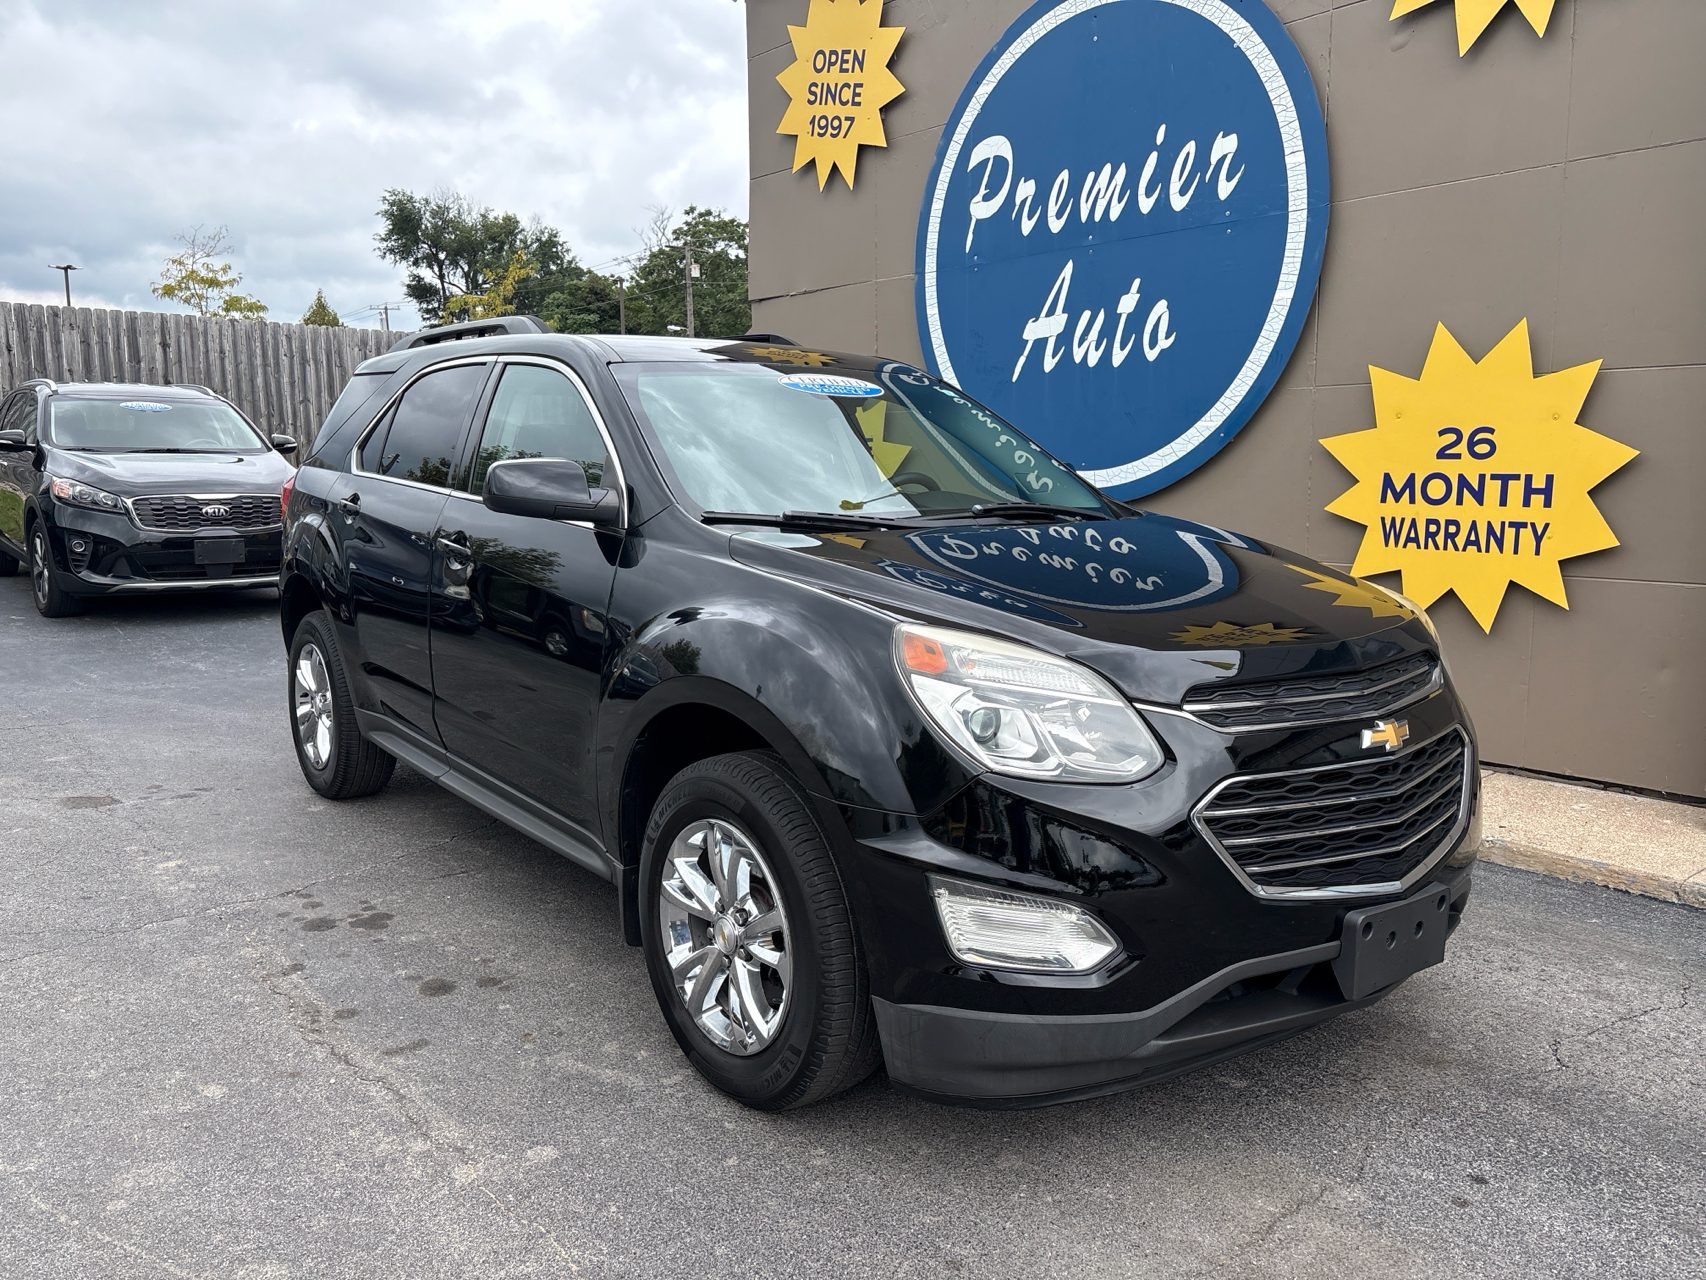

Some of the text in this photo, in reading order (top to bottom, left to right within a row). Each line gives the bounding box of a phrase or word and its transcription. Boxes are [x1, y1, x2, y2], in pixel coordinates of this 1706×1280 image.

[812, 48, 867, 74] OPEN
[806, 81, 864, 107] SINCE
[809, 114, 856, 139] 1997
[965, 123, 1245, 254] Premier
[1011, 258, 1177, 383] Auto
[1435, 426, 1498, 461] 26
[1379, 471, 1556, 509] MONTH
[1379, 516, 1552, 556] WARRANTY
